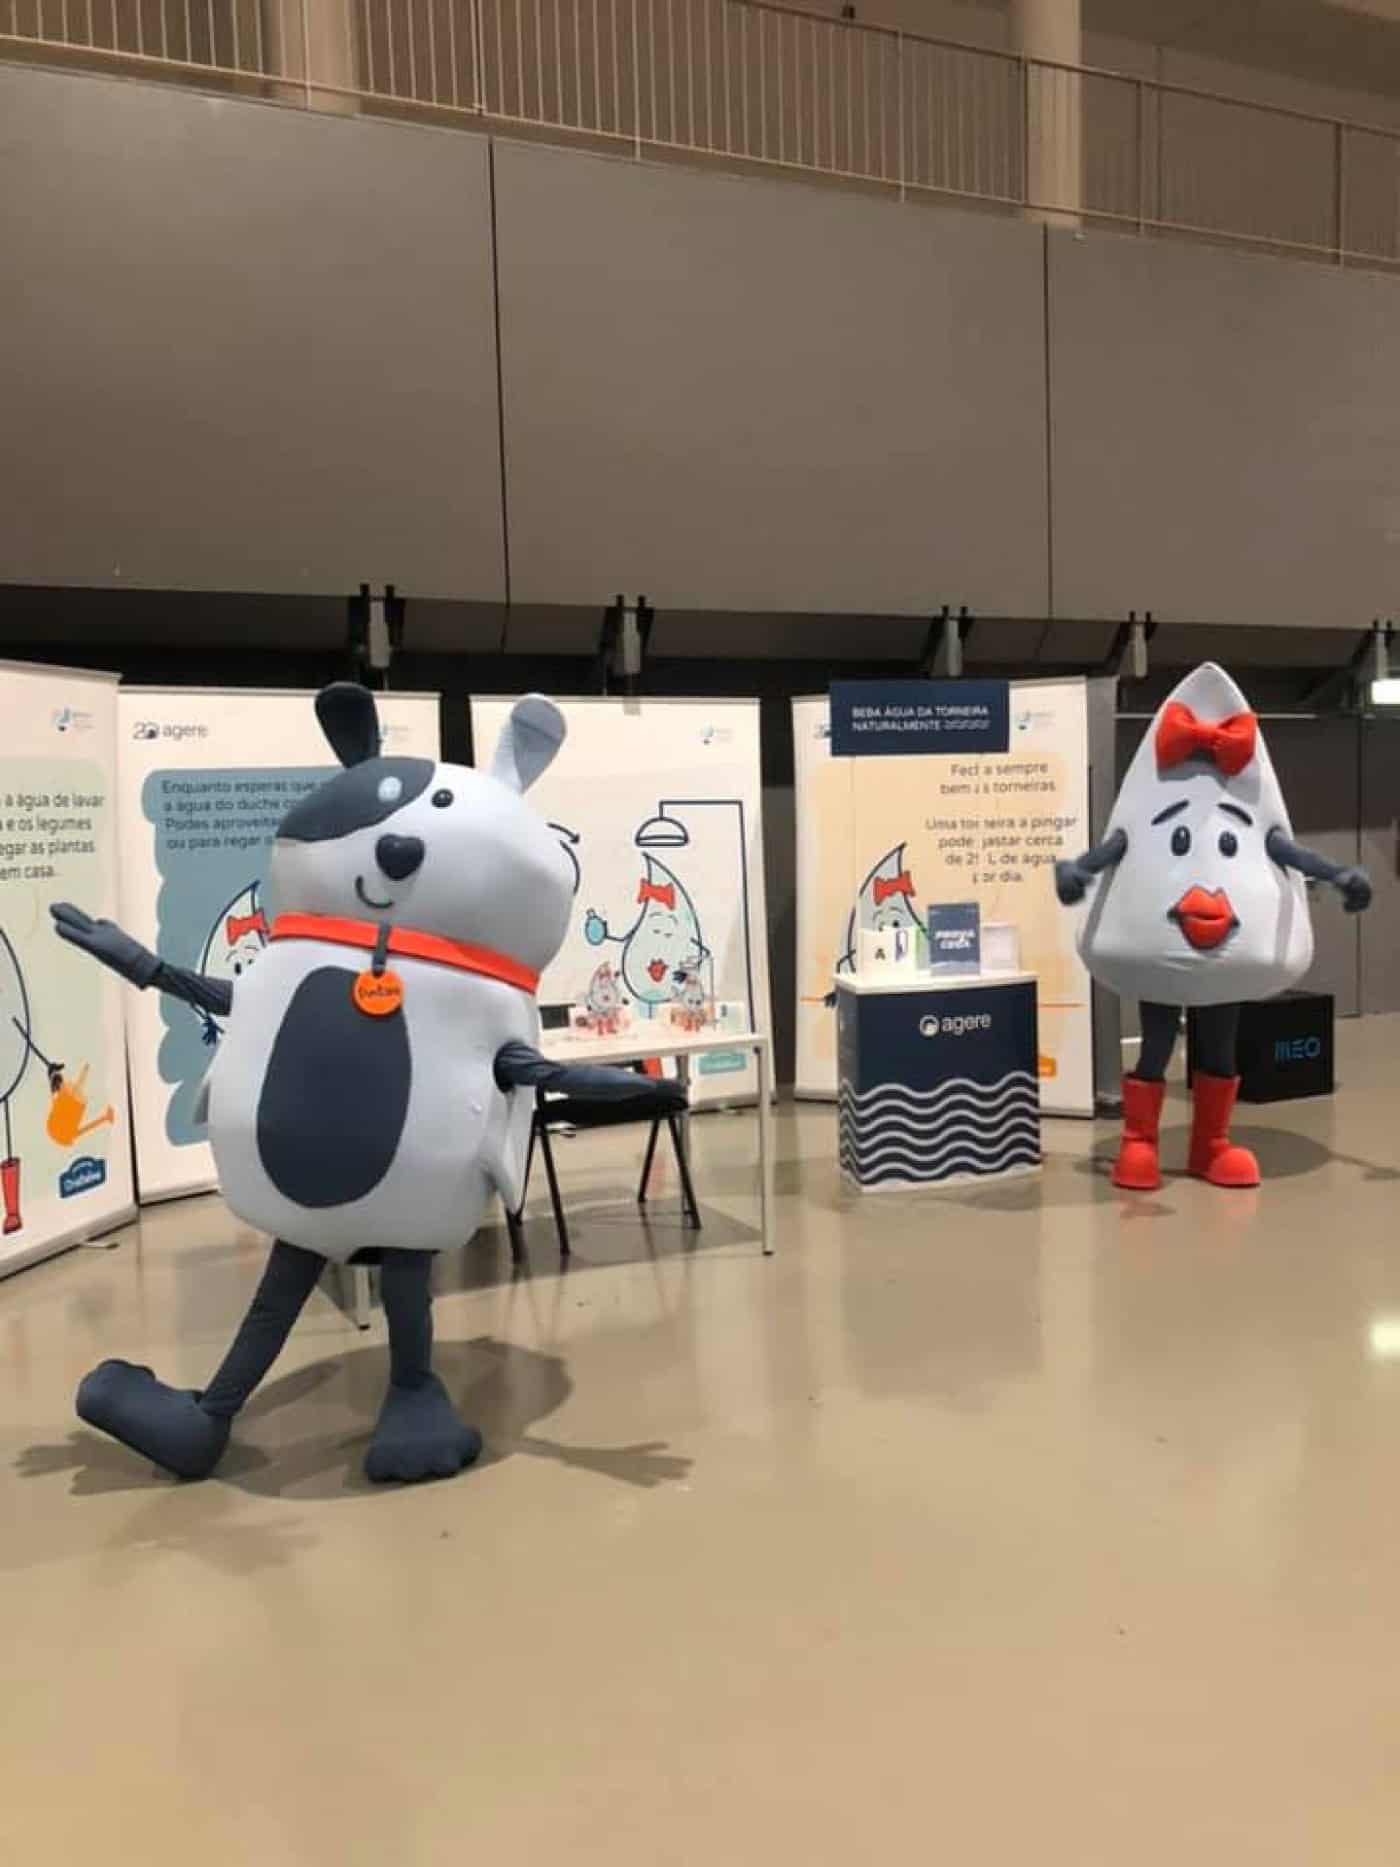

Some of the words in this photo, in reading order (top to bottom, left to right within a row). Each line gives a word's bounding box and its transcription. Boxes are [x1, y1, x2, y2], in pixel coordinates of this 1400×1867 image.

[852, 706, 881, 718] BEBA
[884, 704, 914, 717] ÁGUA
[917, 706, 933, 717] DA
[936, 705, 989, 716] TORNEIRA
[852, 719, 941, 731] NATURALMENTE
[996, 762, 1048, 775] sempre
[161, 780, 231, 795] Enquanto
[235, 781, 287, 796] esperas
[940, 783, 971, 794] bem
[993, 780, 1056, 793] torneiras
[16, 794, 49, 812] água
[55, 794, 69, 808] de
[71, 794, 104, 808] lavar
[164, 803, 172, 812] a
[176, 799, 211, 815] água
[216, 800, 234, 810] do
[238, 799, 279, 811] duche
[18, 819, 34, 831] os
[37, 816, 92, 835] legumes
[166, 818, 208, 831] Podes
[925, 818, 957, 831] Uma
[1019, 818, 1028, 829] a
[1031, 816, 1076, 832] pingar
[30, 842, 45, 855] as
[48, 840, 96, 857] plantas
[167, 839, 185, 849] ou
[189, 838, 220, 850] para
[224, 837, 260, 849] regar
[938, 836, 974, 849] pode
[1025, 834, 1063, 846] cerca
[945, 854, 962, 866] de
[1000, 853, 1018, 865] de
[942, 1013, 992, 1035] agere
